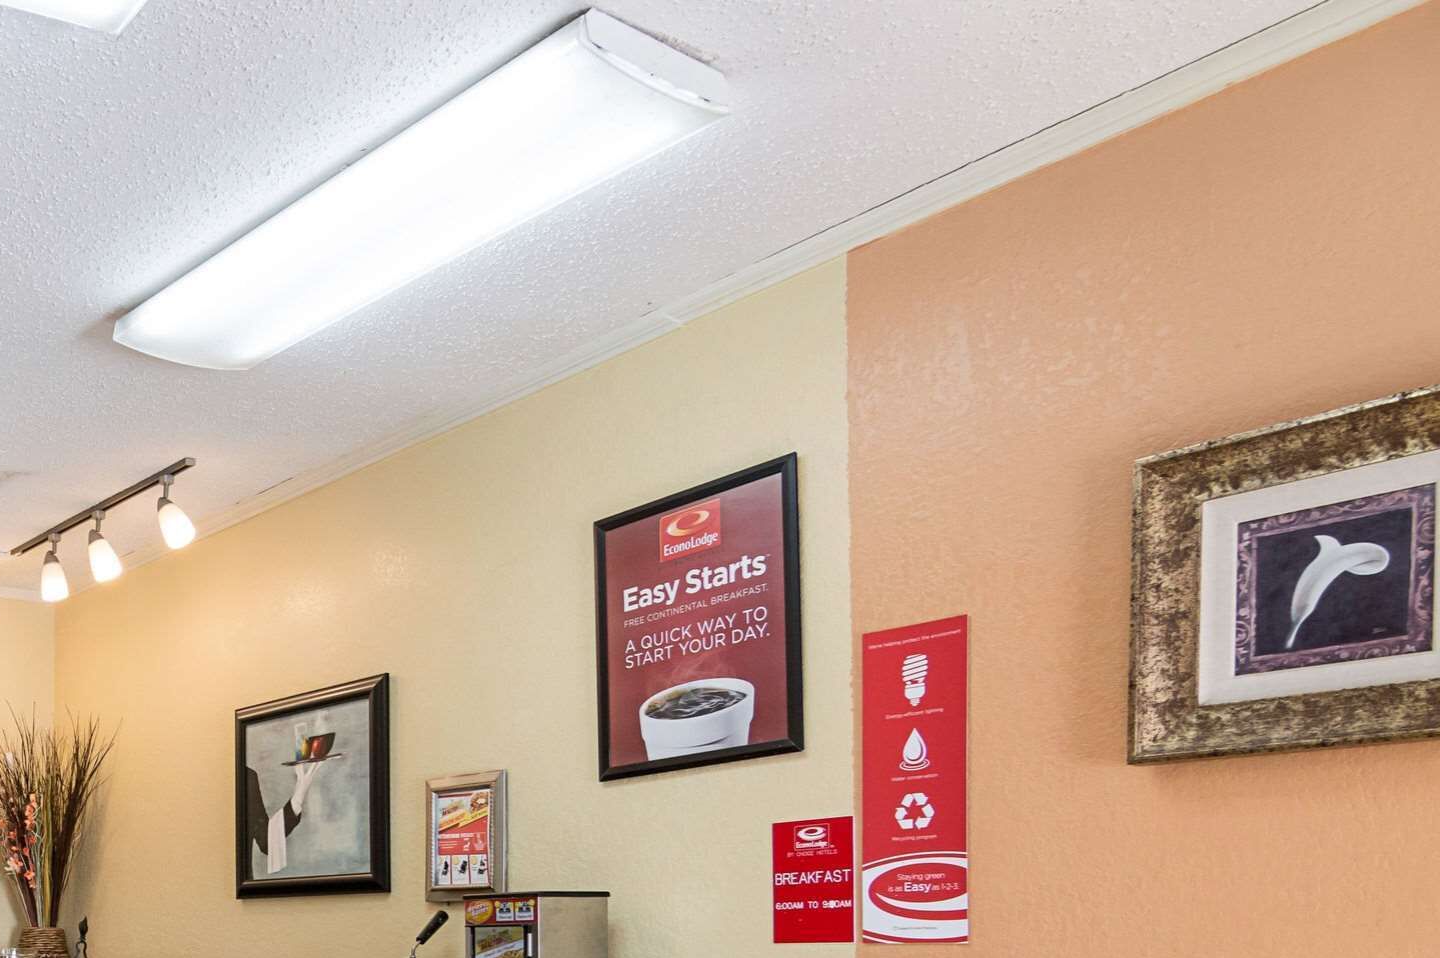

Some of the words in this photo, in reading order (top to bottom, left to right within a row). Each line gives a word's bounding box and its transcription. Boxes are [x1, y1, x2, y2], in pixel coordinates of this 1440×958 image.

[663, 532, 719, 556] EconoLodge
[623, 579, 680, 612] Easy
[685, 554, 767, 594] Starts
[624, 615, 645, 628] FREE
[646, 600, 708, 622] CONTINENTAL
[625, 639, 636, 654] A
[640, 624, 692, 650] QUICK
[697, 613, 737, 635] WAY
[743, 606, 768, 624] TO
[625, 645, 674, 669] START
[679, 633, 726, 656] YOUR
[731, 623, 771, 644] DAY.
[774, 869, 851, 886] BREAKFAST
[903, 881, 932, 894] Easy
[807, 901, 819, 909] TO
